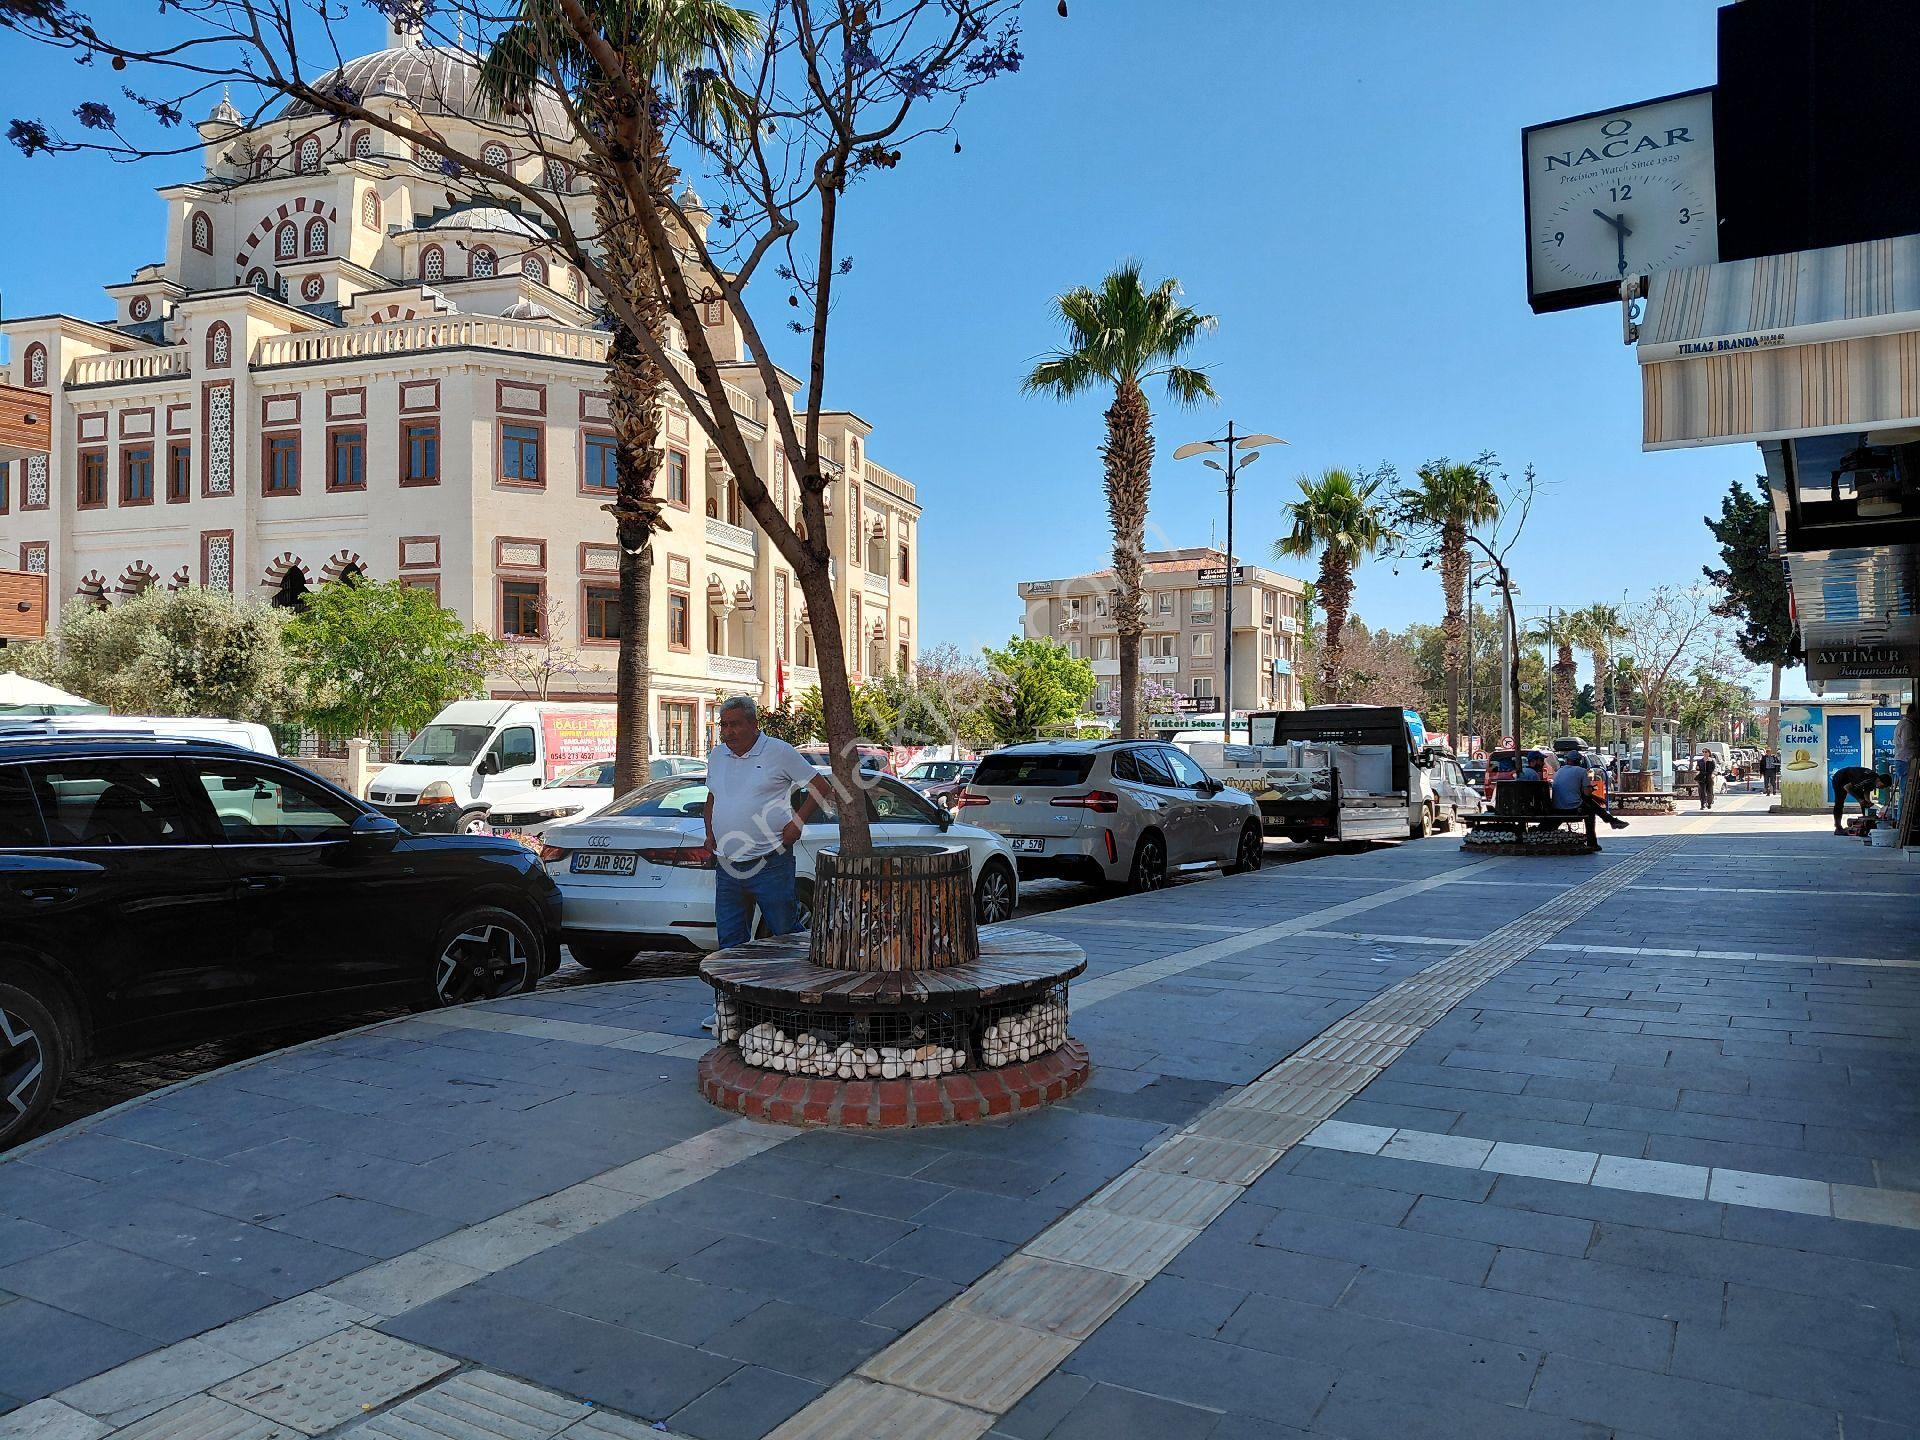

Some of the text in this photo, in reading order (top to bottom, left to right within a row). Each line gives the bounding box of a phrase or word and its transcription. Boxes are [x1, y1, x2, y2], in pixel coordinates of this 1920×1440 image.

[1544, 127, 1694, 172] NACAR
[1559, 154, 1680, 184] Precision Watch Since 1929
[1609, 184, 1632, 202] 12
[1679, 208, 1691, 224] 3
[1554, 232, 1565, 247] 9
[1679, 341, 1714, 355] YILMAZ
[1717, 336, 1760, 351] BRANDA
[1816, 649, 1899, 664] AYTİMUR
[1838, 665, 1909, 677] Kuyumculuk
[1191, 719, 1216, 728] Sebze
[1791, 723, 1814, 733] Halk
[1785, 734, 1819, 744] Ekmek
[577, 855, 633, 871] 09 AIR 802
